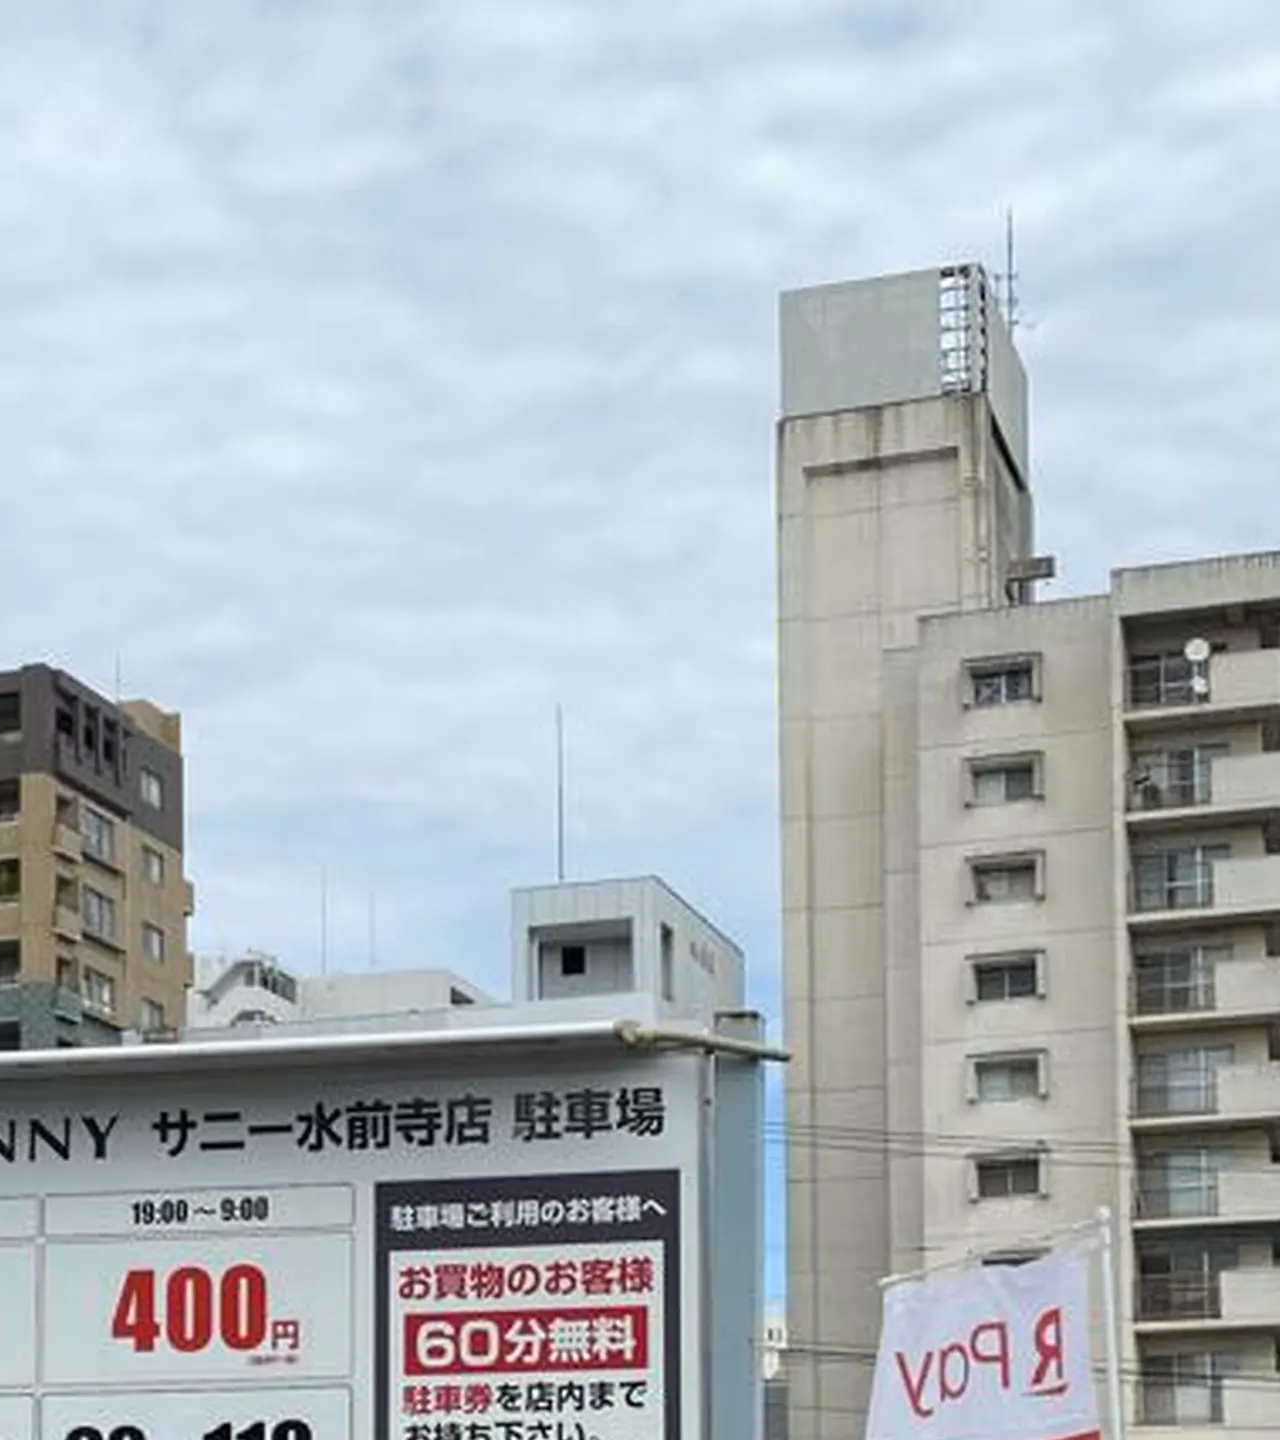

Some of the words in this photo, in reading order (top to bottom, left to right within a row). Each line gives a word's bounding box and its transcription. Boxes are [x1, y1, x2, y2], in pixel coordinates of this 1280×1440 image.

[152, 1098, 492, 1156] サニー水前寺店
[514, 1087, 666, 1142] 駐車場
[389, 1195, 667, 1232] 駐車場ご利用のお客様へ
[398, 1256, 654, 1300] お買物のお客様
[416, 1315, 639, 1369] 60分無料
[401, 1380, 647, 1415] 駐車券を店内まで
